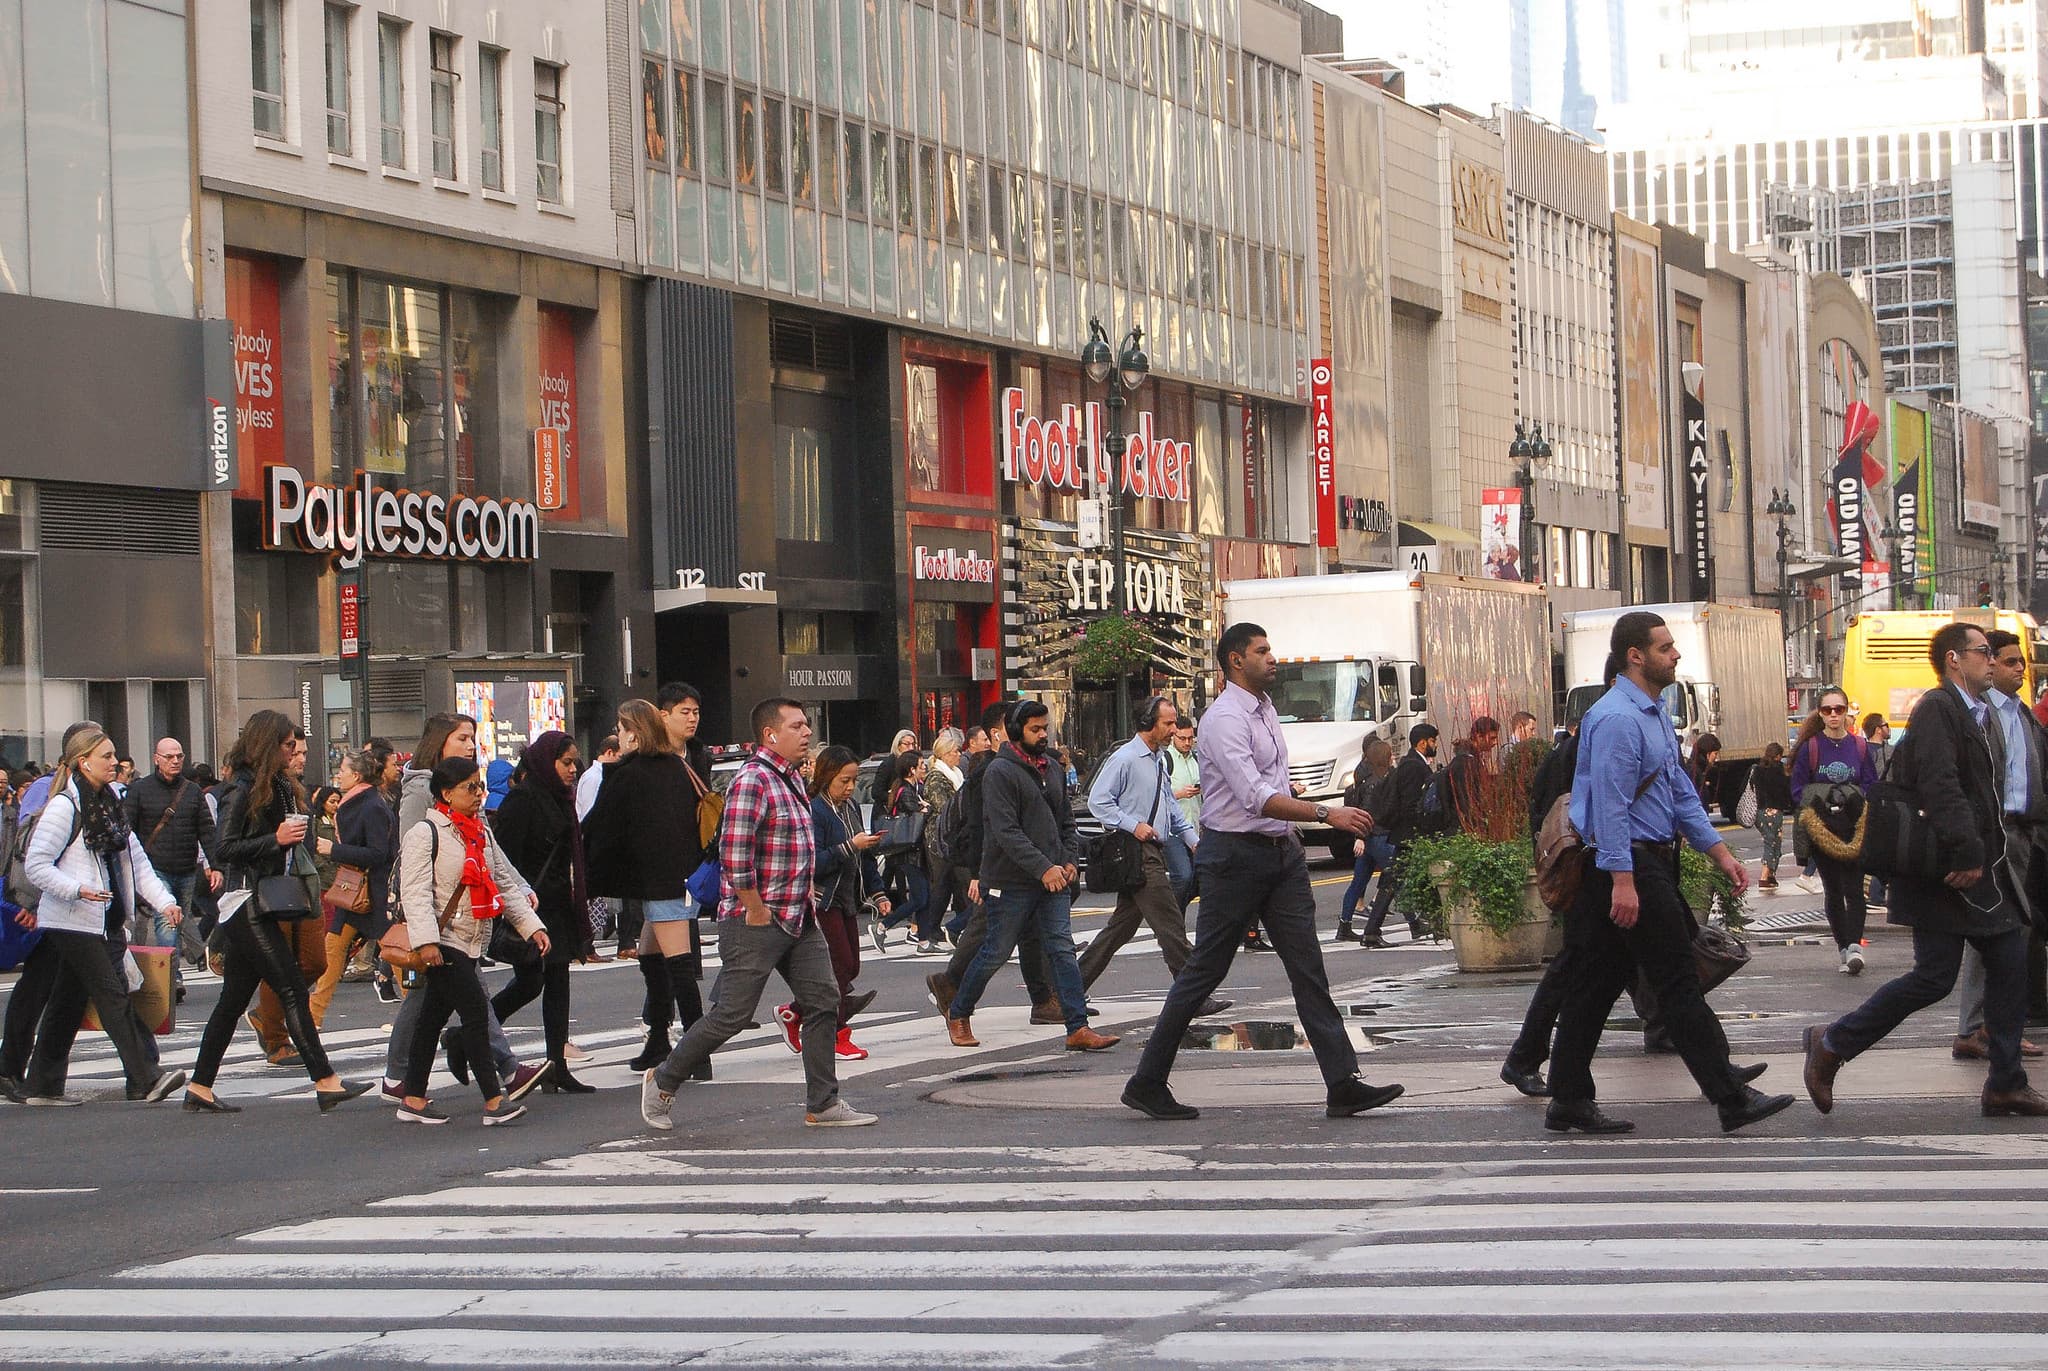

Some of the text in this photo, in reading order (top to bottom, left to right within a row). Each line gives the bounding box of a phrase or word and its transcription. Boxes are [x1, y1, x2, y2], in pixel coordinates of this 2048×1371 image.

[211, 406, 229, 485] verizon
[1002, 387, 1083, 490] Foot
[1316, 395, 1331, 496] TARGET
[1688, 419, 1708, 495] KAY
[272, 465, 539, 569] Payless.com
[1838, 477, 1862, 580] OLD NAVY
[1898, 493, 1915, 584] OLD NAV
[676, 568, 706, 589] 112
[302, 681, 313, 737] Newsstand
[789, 670, 852, 687] HOUR PASSION
